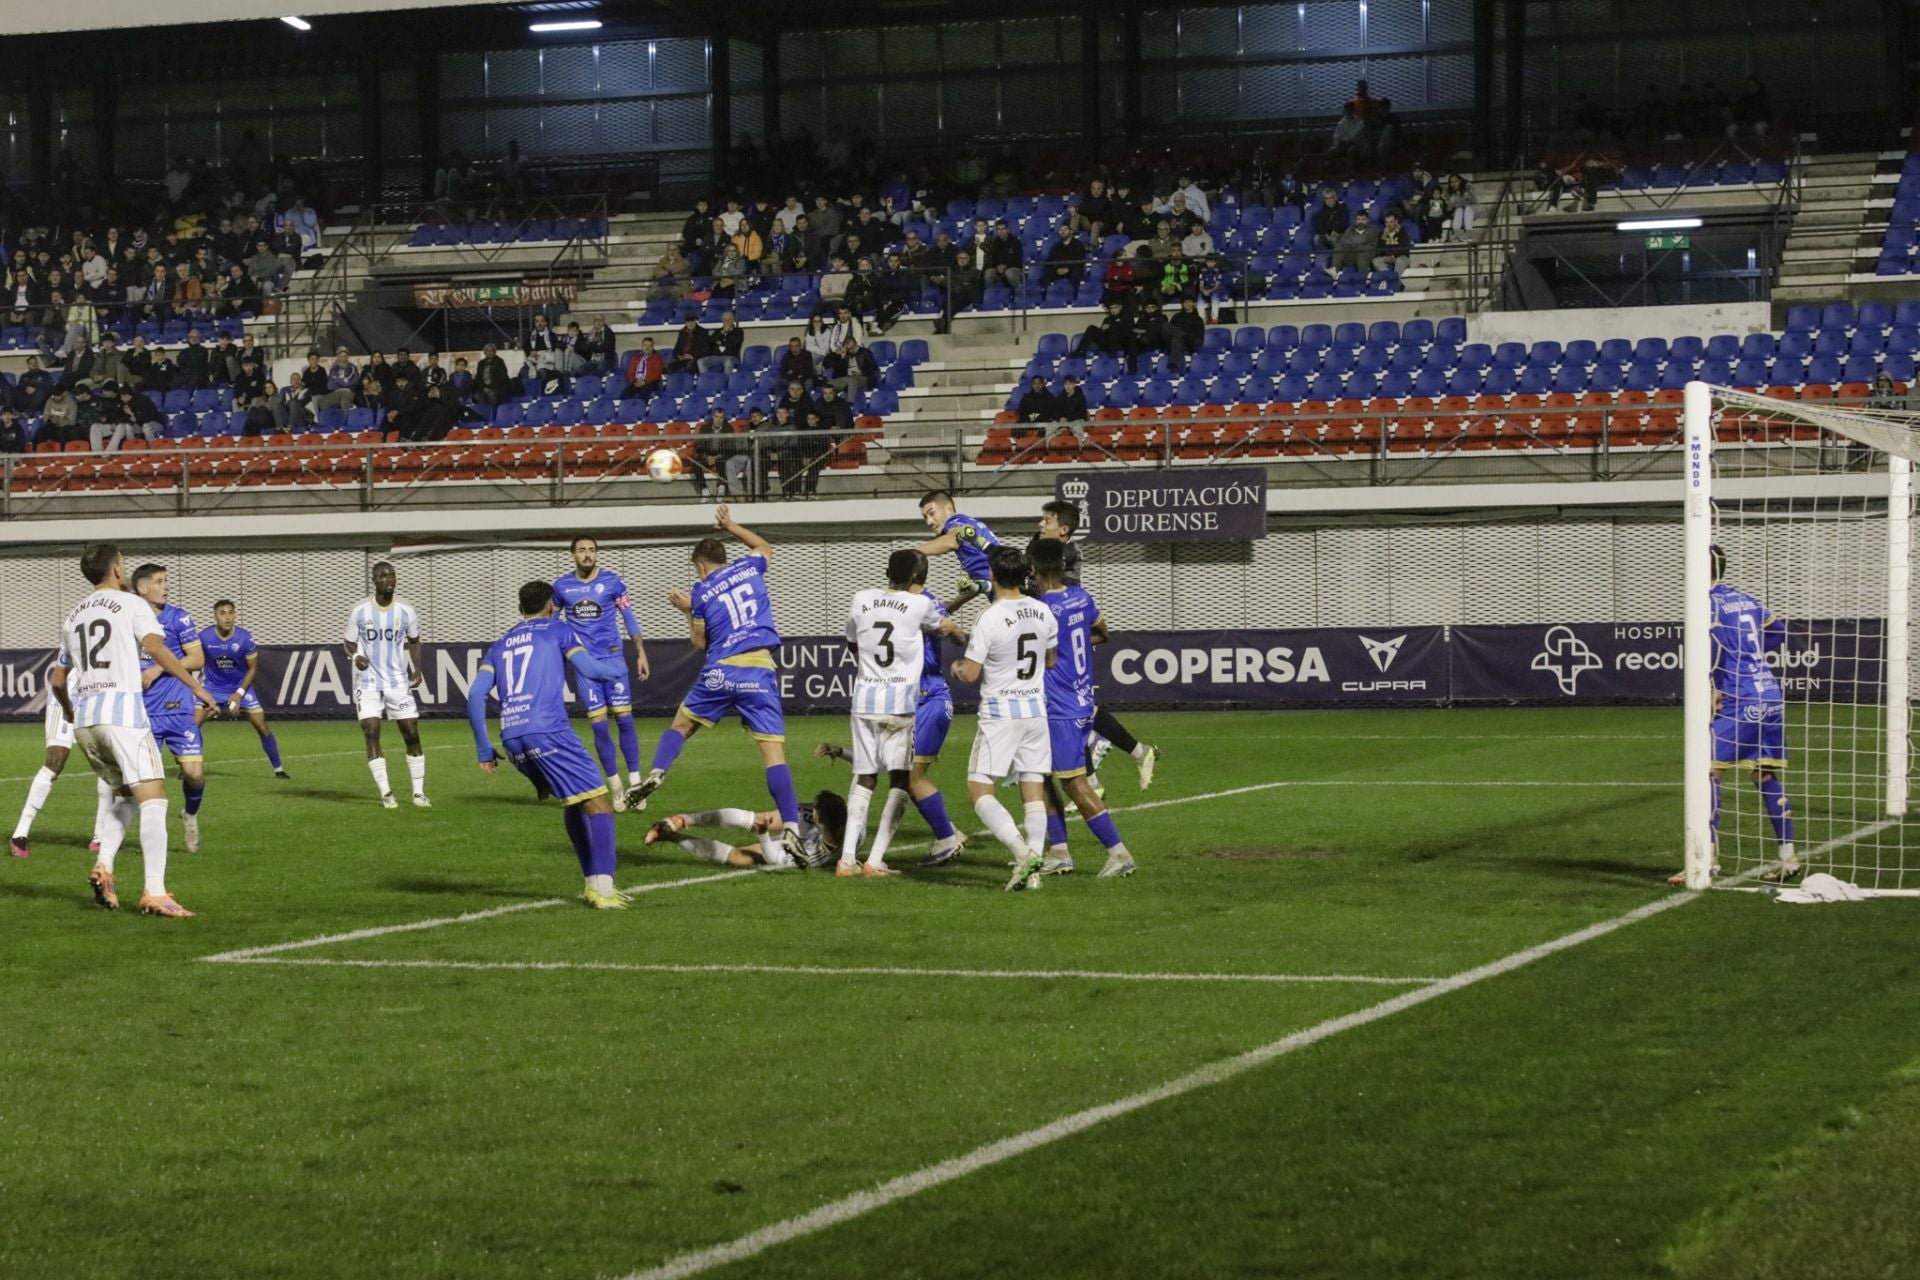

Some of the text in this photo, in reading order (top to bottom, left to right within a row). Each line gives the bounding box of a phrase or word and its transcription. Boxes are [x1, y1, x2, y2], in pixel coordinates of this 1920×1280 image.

[1691, 444, 1701, 487] MONDO
[1105, 481, 1261, 508] DEPUTACIÓN
[1105, 512, 1219, 533] OURENSE
[701, 580, 728, 602] DAVID
[70, 598, 122, 622] DANI CALVO
[717, 583, 758, 630] 16
[862, 599, 908, 614] A. RAHIM
[1005, 608, 1044, 628] A. REINA
[74, 618, 112, 672] 12
[367, 628, 399, 641] DIGI
[505, 632, 532, 647] OMAR
[872, 621, 895, 668] 3
[1615, 627, 1684, 640] HOSPIT
[771, 644, 859, 668] UNTA
[1017, 632, 1038, 680] 5
[1070, 627, 1087, 676] 8
[1615, 643, 1819, 670] recol alud
[502, 645, 533, 696] 17
[1110, 647, 1331, 685] COPERSA
[589, 688, 598, 703] 4
[1342, 680, 1426, 692] CUPRA
[1780, 678, 1820, 690] MEN
